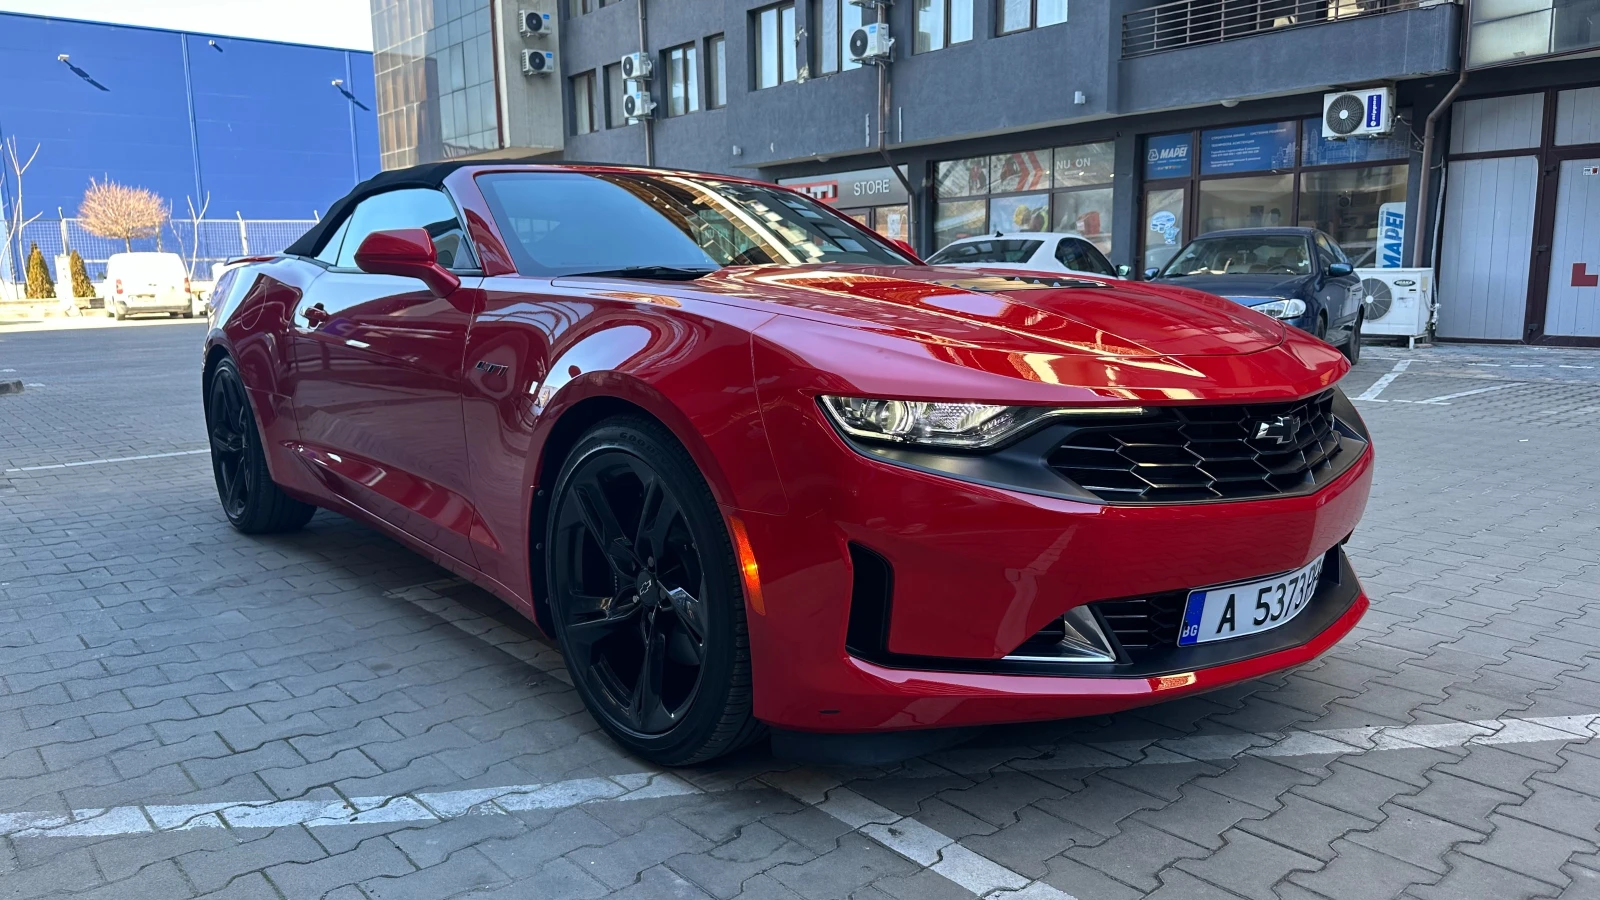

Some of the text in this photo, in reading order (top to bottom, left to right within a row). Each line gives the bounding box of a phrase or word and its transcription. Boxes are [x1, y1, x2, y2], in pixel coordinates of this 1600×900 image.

[1160, 147, 1188, 159] MAPEI
[796, 179, 890, 199] LTI STORE
[1216, 594, 1236, 634] A
[1182, 624, 1198, 638] BG
